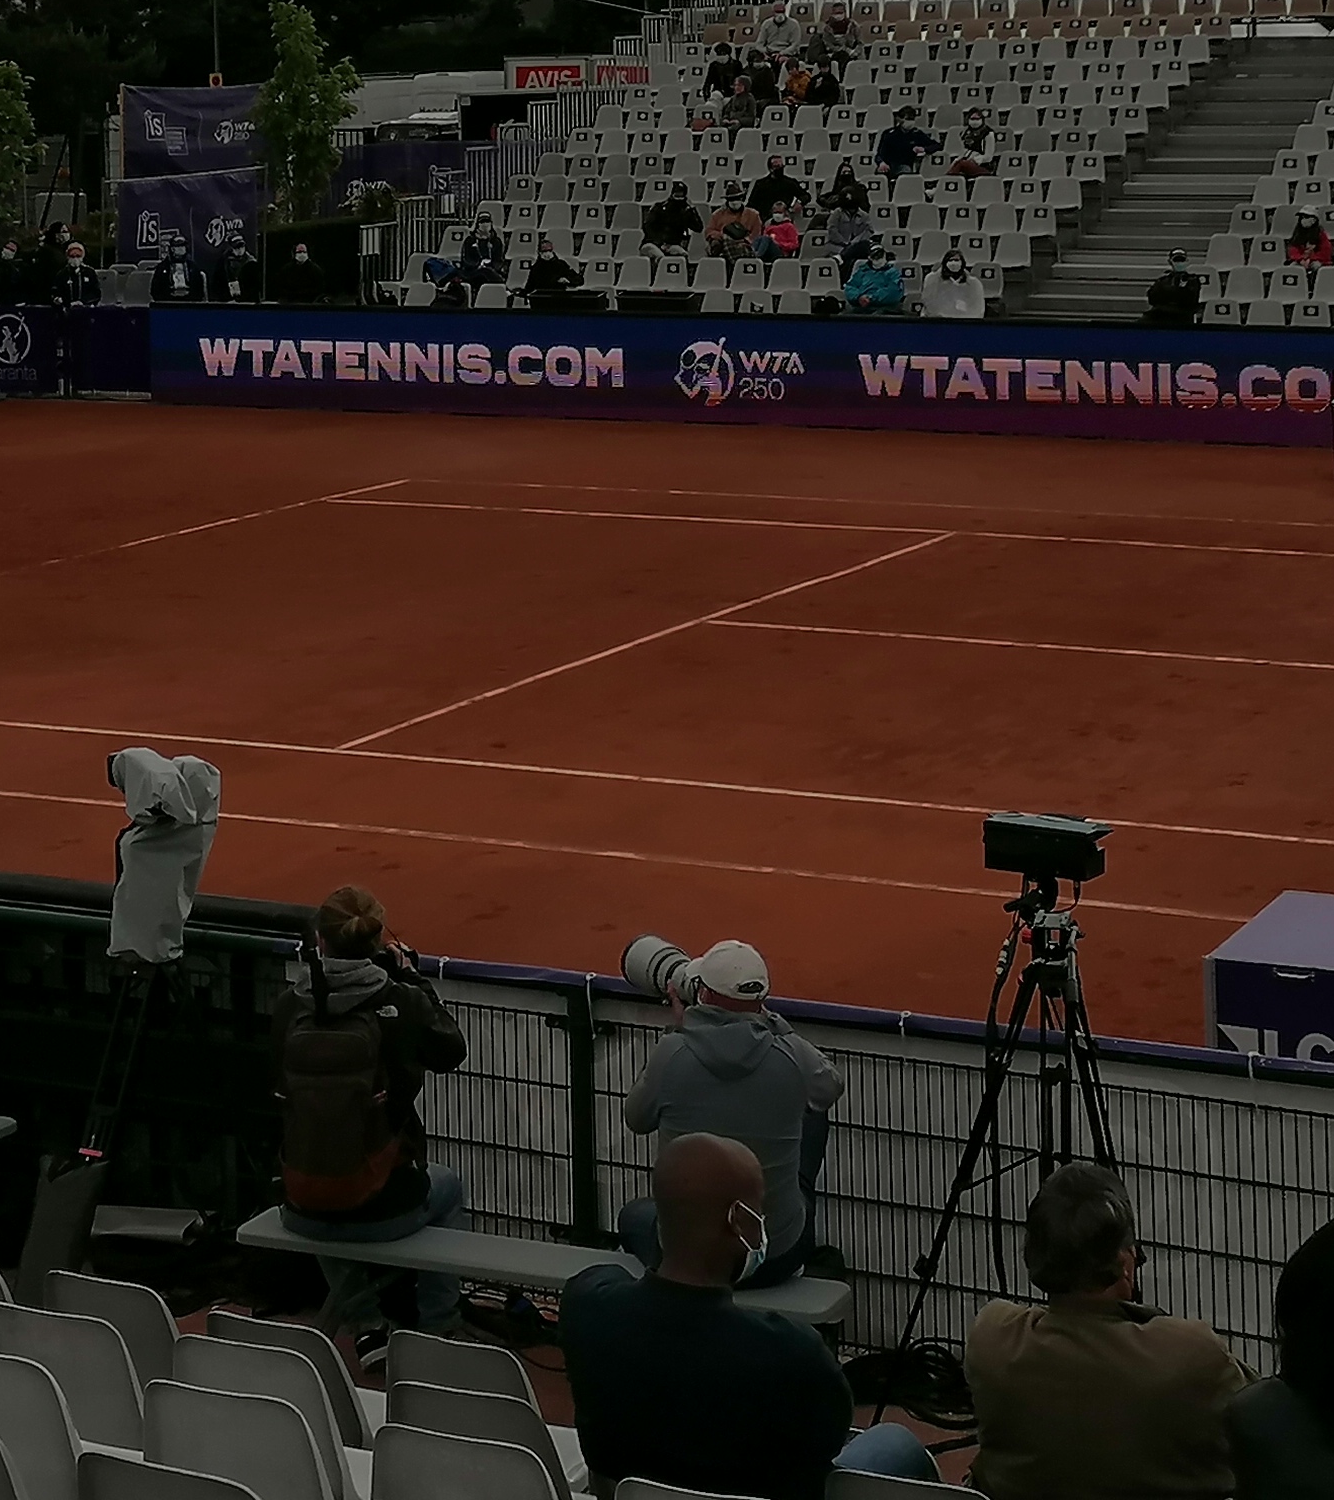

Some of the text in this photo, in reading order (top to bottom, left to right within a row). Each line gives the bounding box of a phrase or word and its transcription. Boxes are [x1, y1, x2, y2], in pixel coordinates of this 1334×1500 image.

[198, 336, 626, 389] WTATENNIS.COM
[738, 350, 806, 374] WTA
[738, 376, 786, 401] 250
